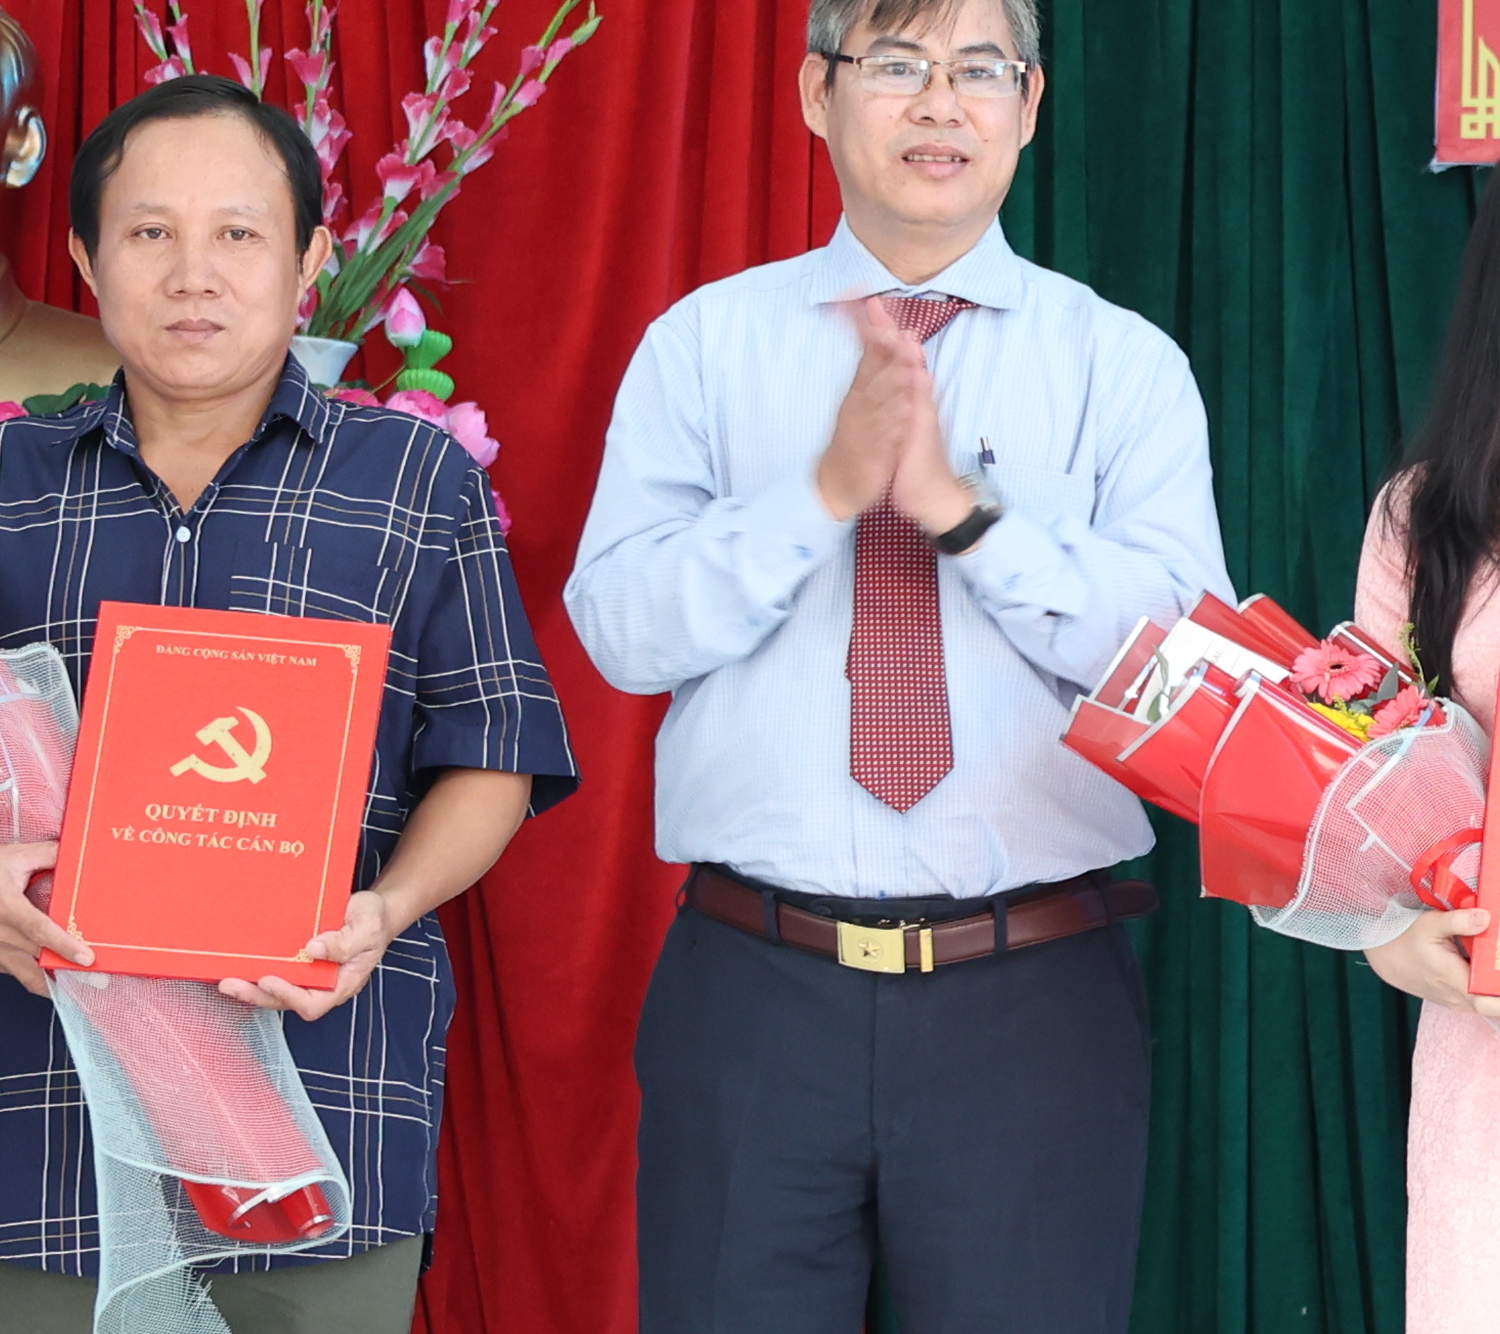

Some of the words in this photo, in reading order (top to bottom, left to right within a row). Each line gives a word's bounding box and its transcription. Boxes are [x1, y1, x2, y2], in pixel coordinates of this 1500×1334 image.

[144, 803, 219, 823] QUYẾT
[222, 809, 277, 829] ĐỊNH
[138, 826, 192, 846] CÔNG
[195, 831, 233, 849] TÁC
[235, 834, 275, 853] CÁN
[279, 839, 305, 858] BỘ
